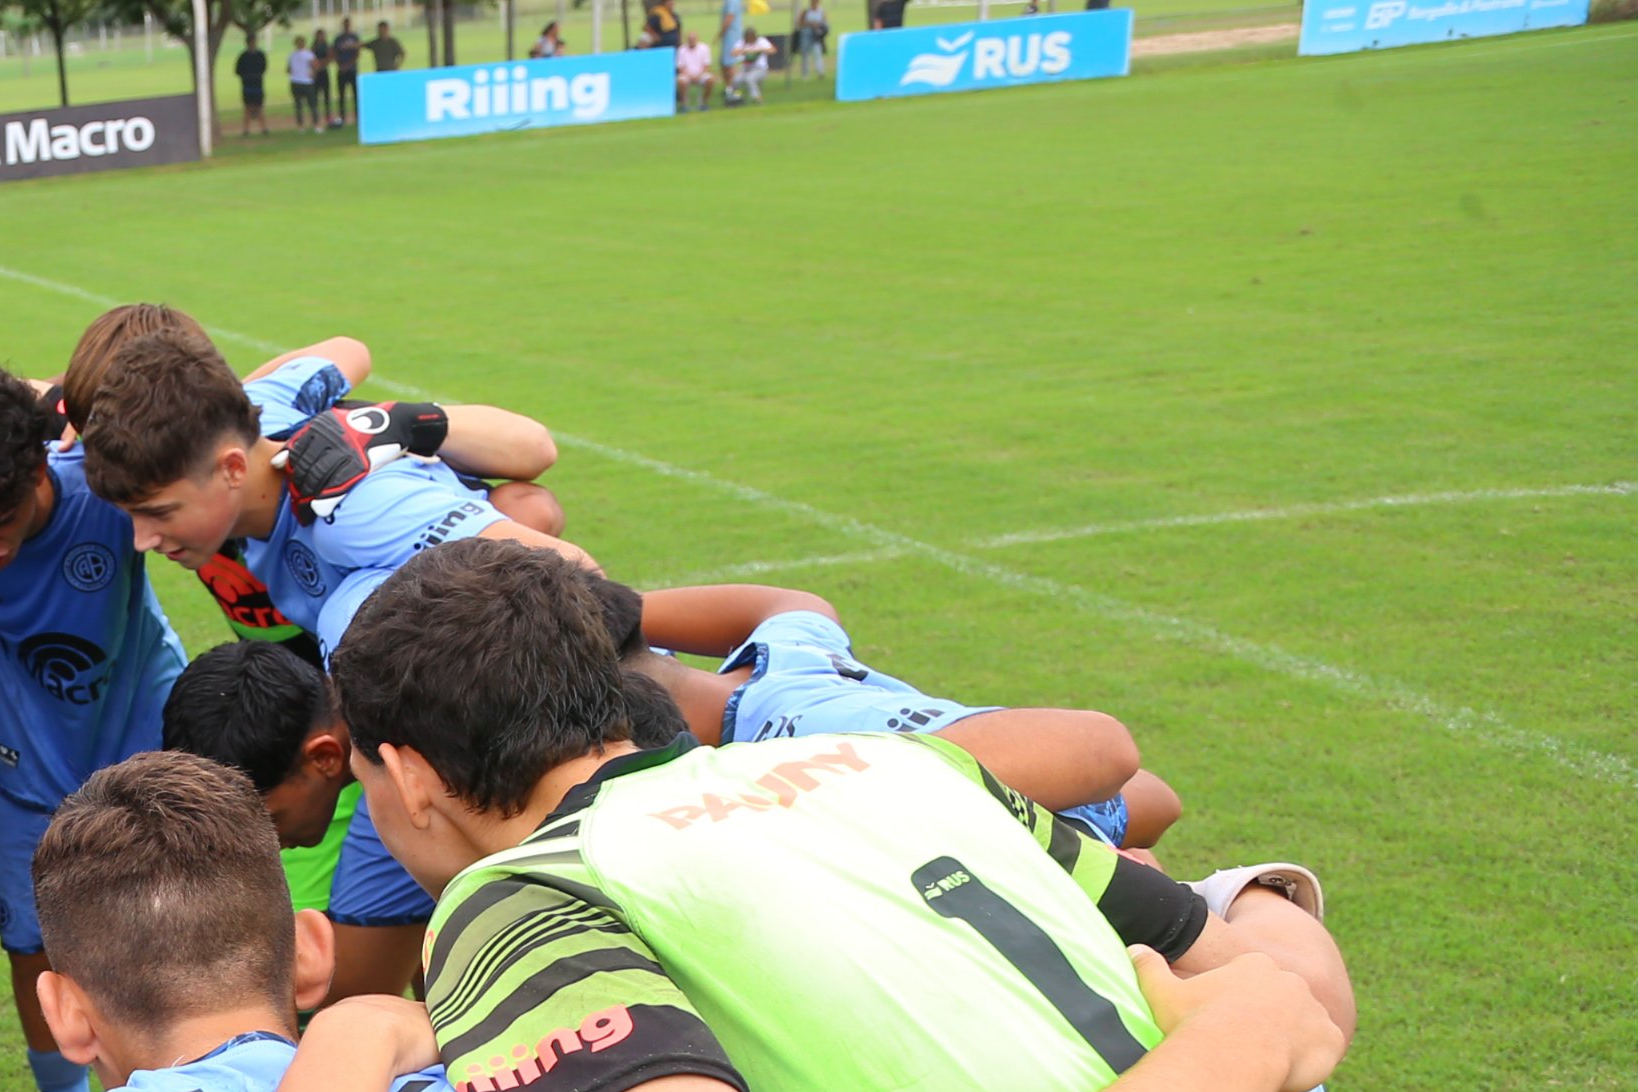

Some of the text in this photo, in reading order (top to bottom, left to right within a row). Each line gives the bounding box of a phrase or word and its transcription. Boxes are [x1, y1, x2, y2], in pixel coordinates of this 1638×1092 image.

[973, 31, 1072, 79] RUS
[425, 65, 609, 122] Riiing
[5, 116, 155, 166] Macro
[938, 869, 970, 892] RUS
[911, 855, 1150, 1076] 1
